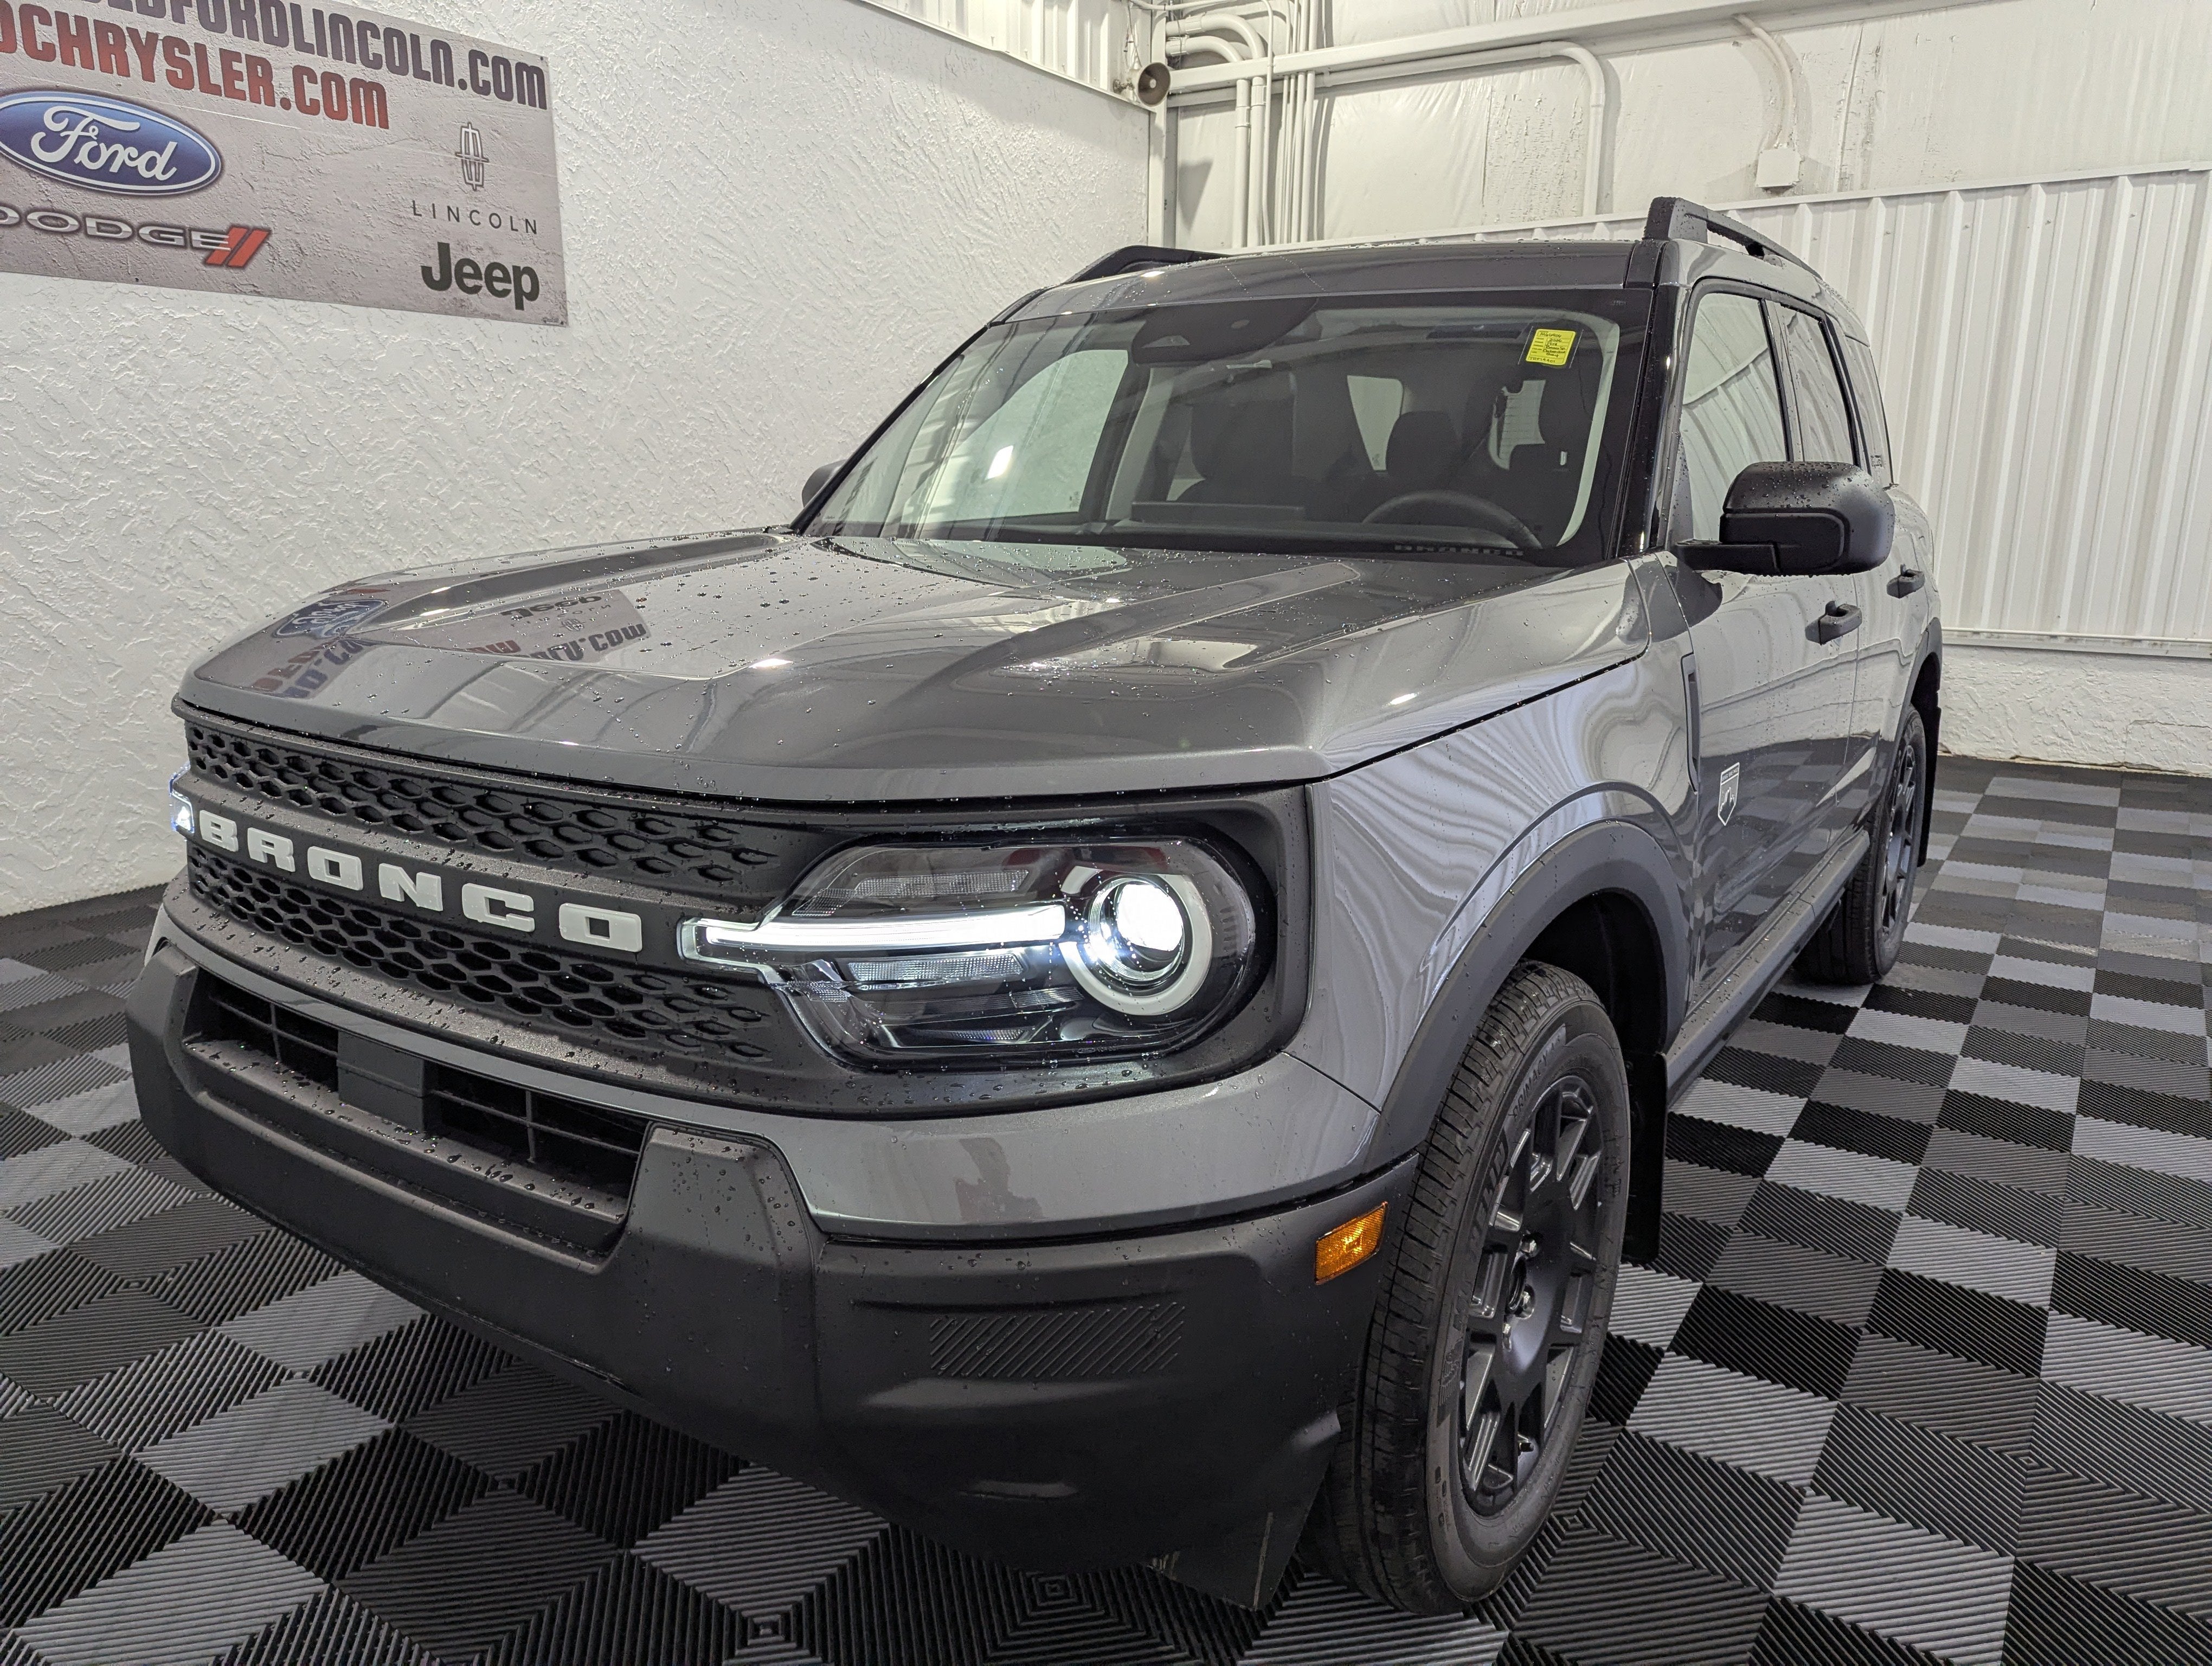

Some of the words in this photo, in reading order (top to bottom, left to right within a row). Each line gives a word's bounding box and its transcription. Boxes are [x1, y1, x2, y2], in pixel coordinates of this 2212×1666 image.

[82, 0, 547, 110] ORDLINCOLN.COM
[31, 105, 178, 181] Ford
[412, 200, 537, 235] LINCOLN
[421, 241, 540, 311] Jeep
[198, 810, 643, 953] BRONCO
